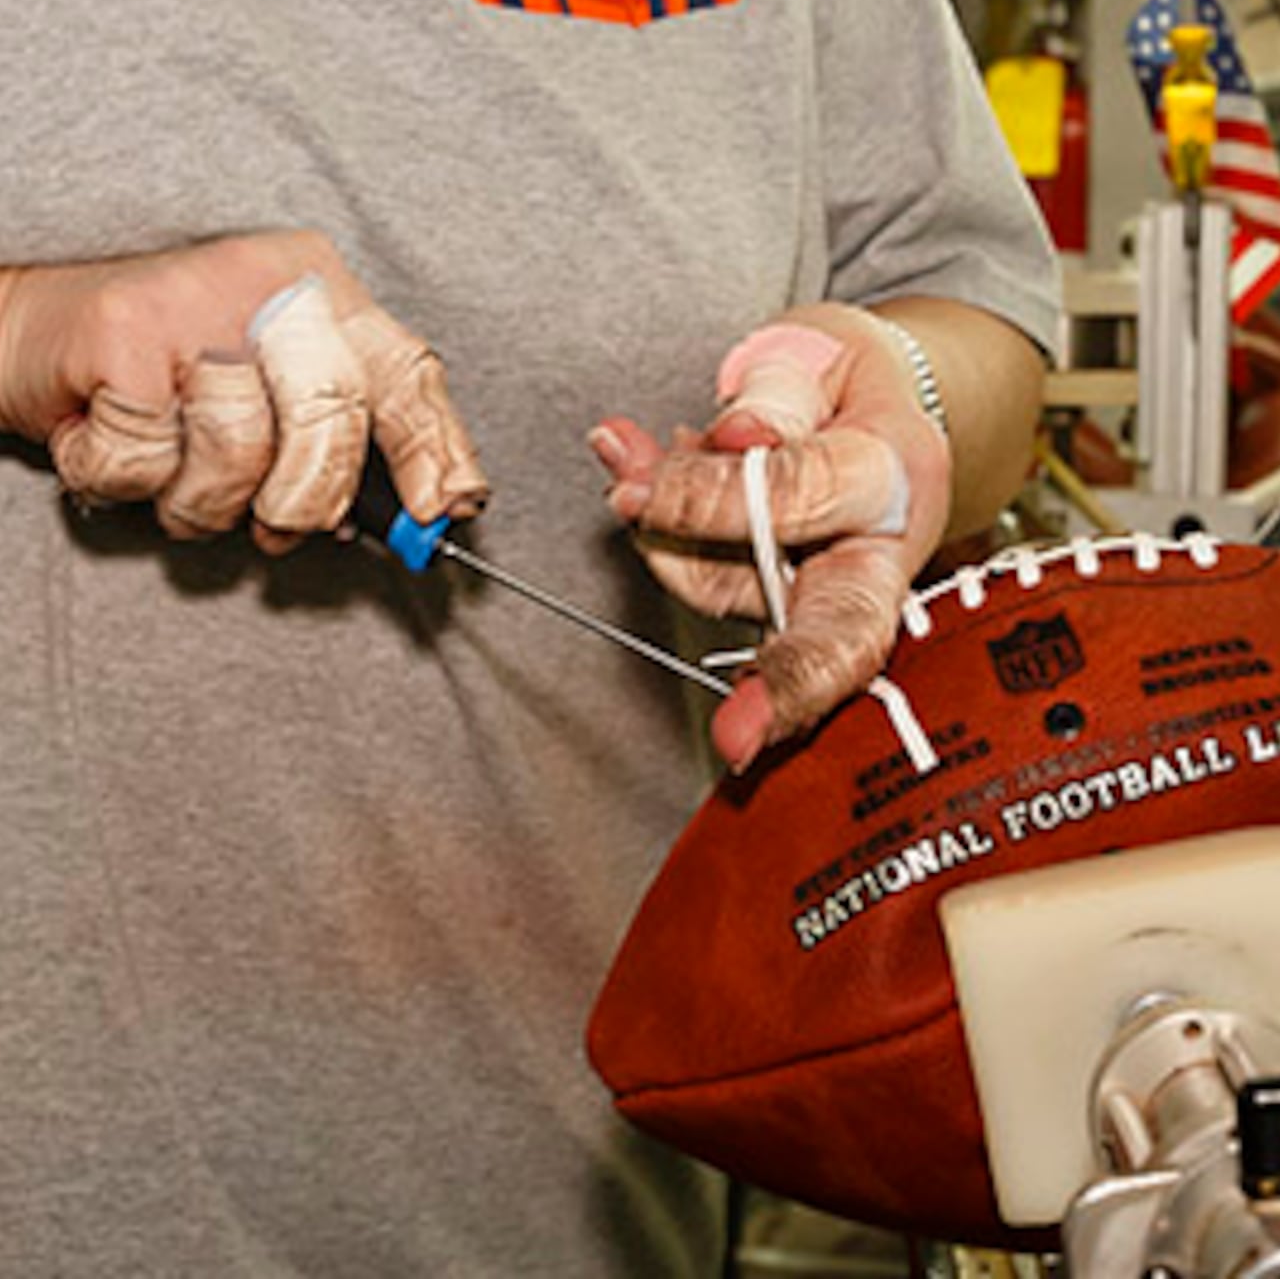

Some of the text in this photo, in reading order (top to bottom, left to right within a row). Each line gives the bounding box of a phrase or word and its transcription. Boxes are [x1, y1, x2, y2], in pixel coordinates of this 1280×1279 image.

[1000, 635, 1082, 690] NFL
[793, 822, 994, 951] NATIONAL
[1000, 736, 1238, 841] FOOTBALL
